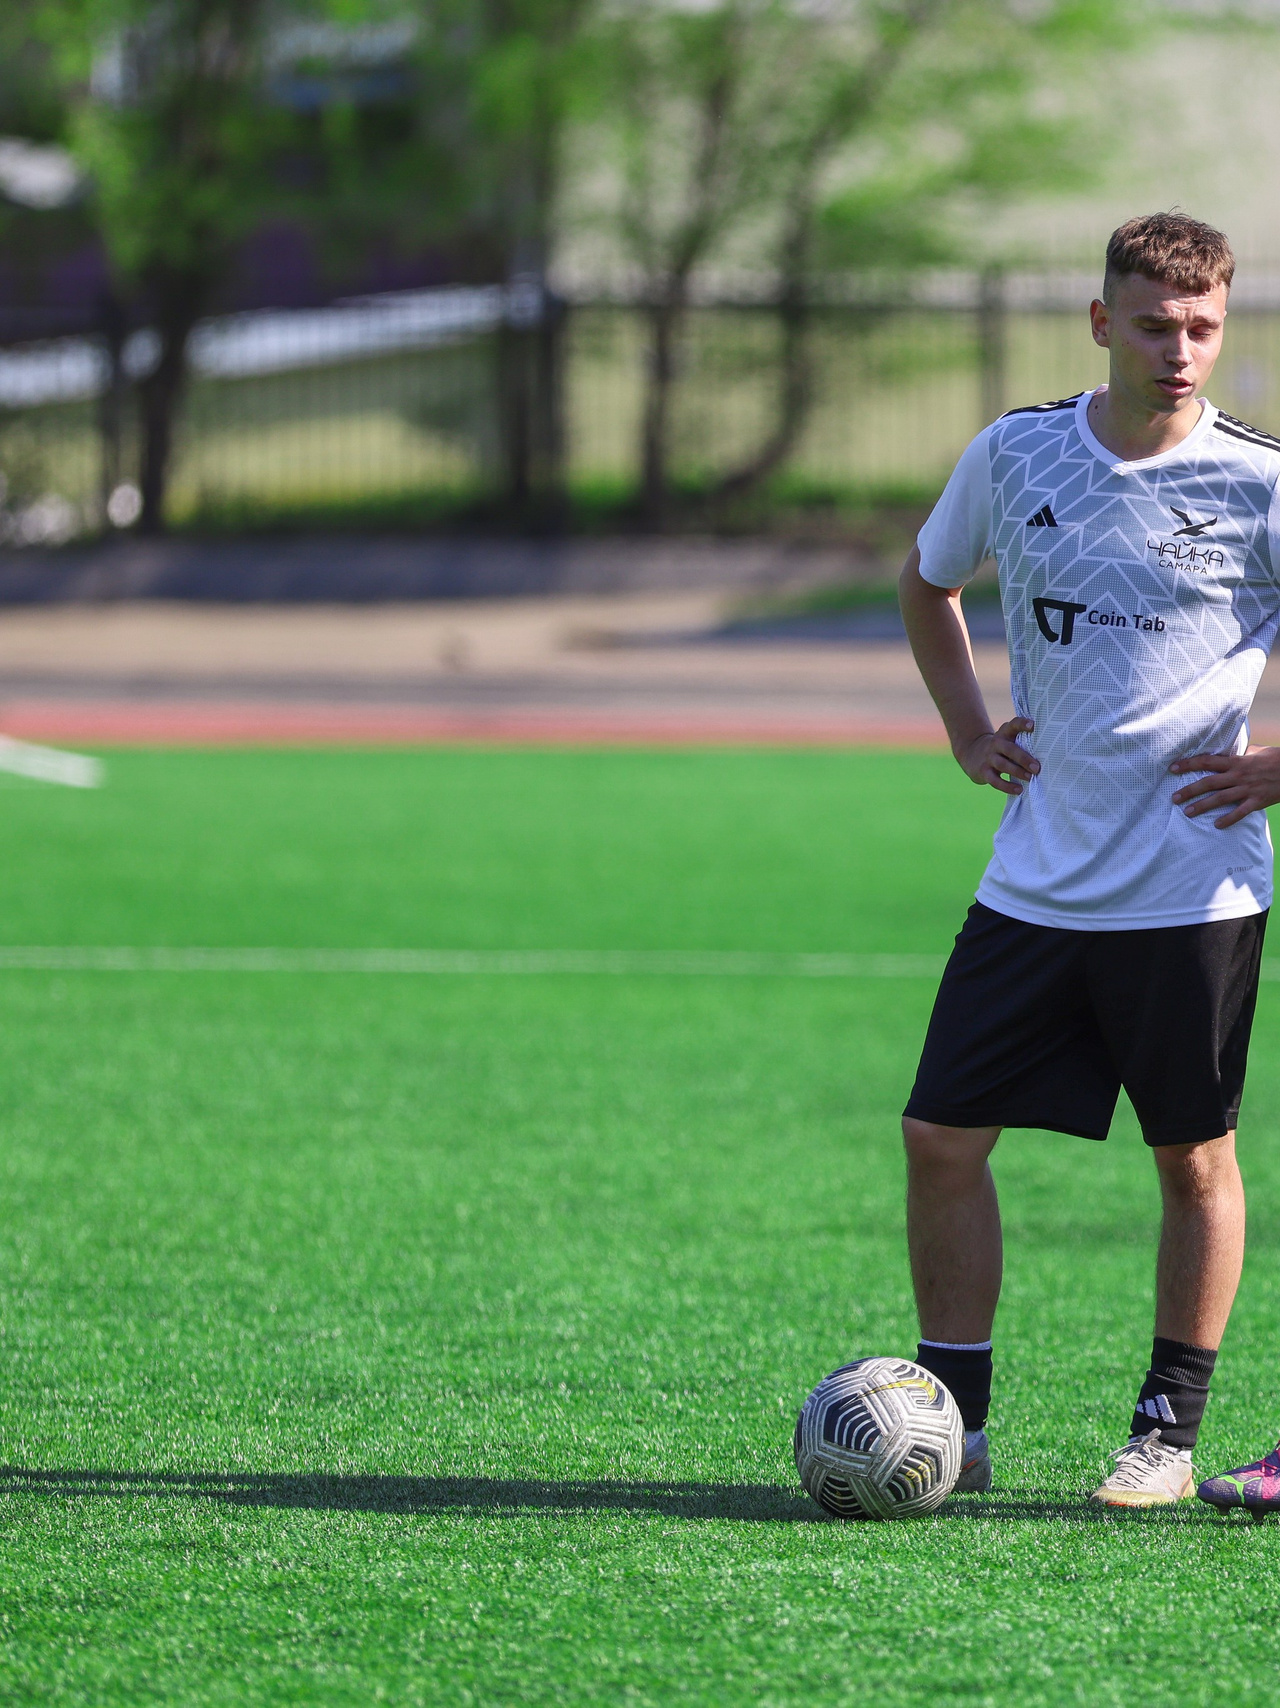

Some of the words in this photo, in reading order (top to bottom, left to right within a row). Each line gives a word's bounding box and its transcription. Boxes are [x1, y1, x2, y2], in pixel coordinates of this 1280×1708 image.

[1147, 540, 1224, 568] ЧАЙКА
[1159, 559, 1208, 575] САМАРА
[1088, 610, 1127, 628] Coin
[1133, 614, 1166, 632] Tab
